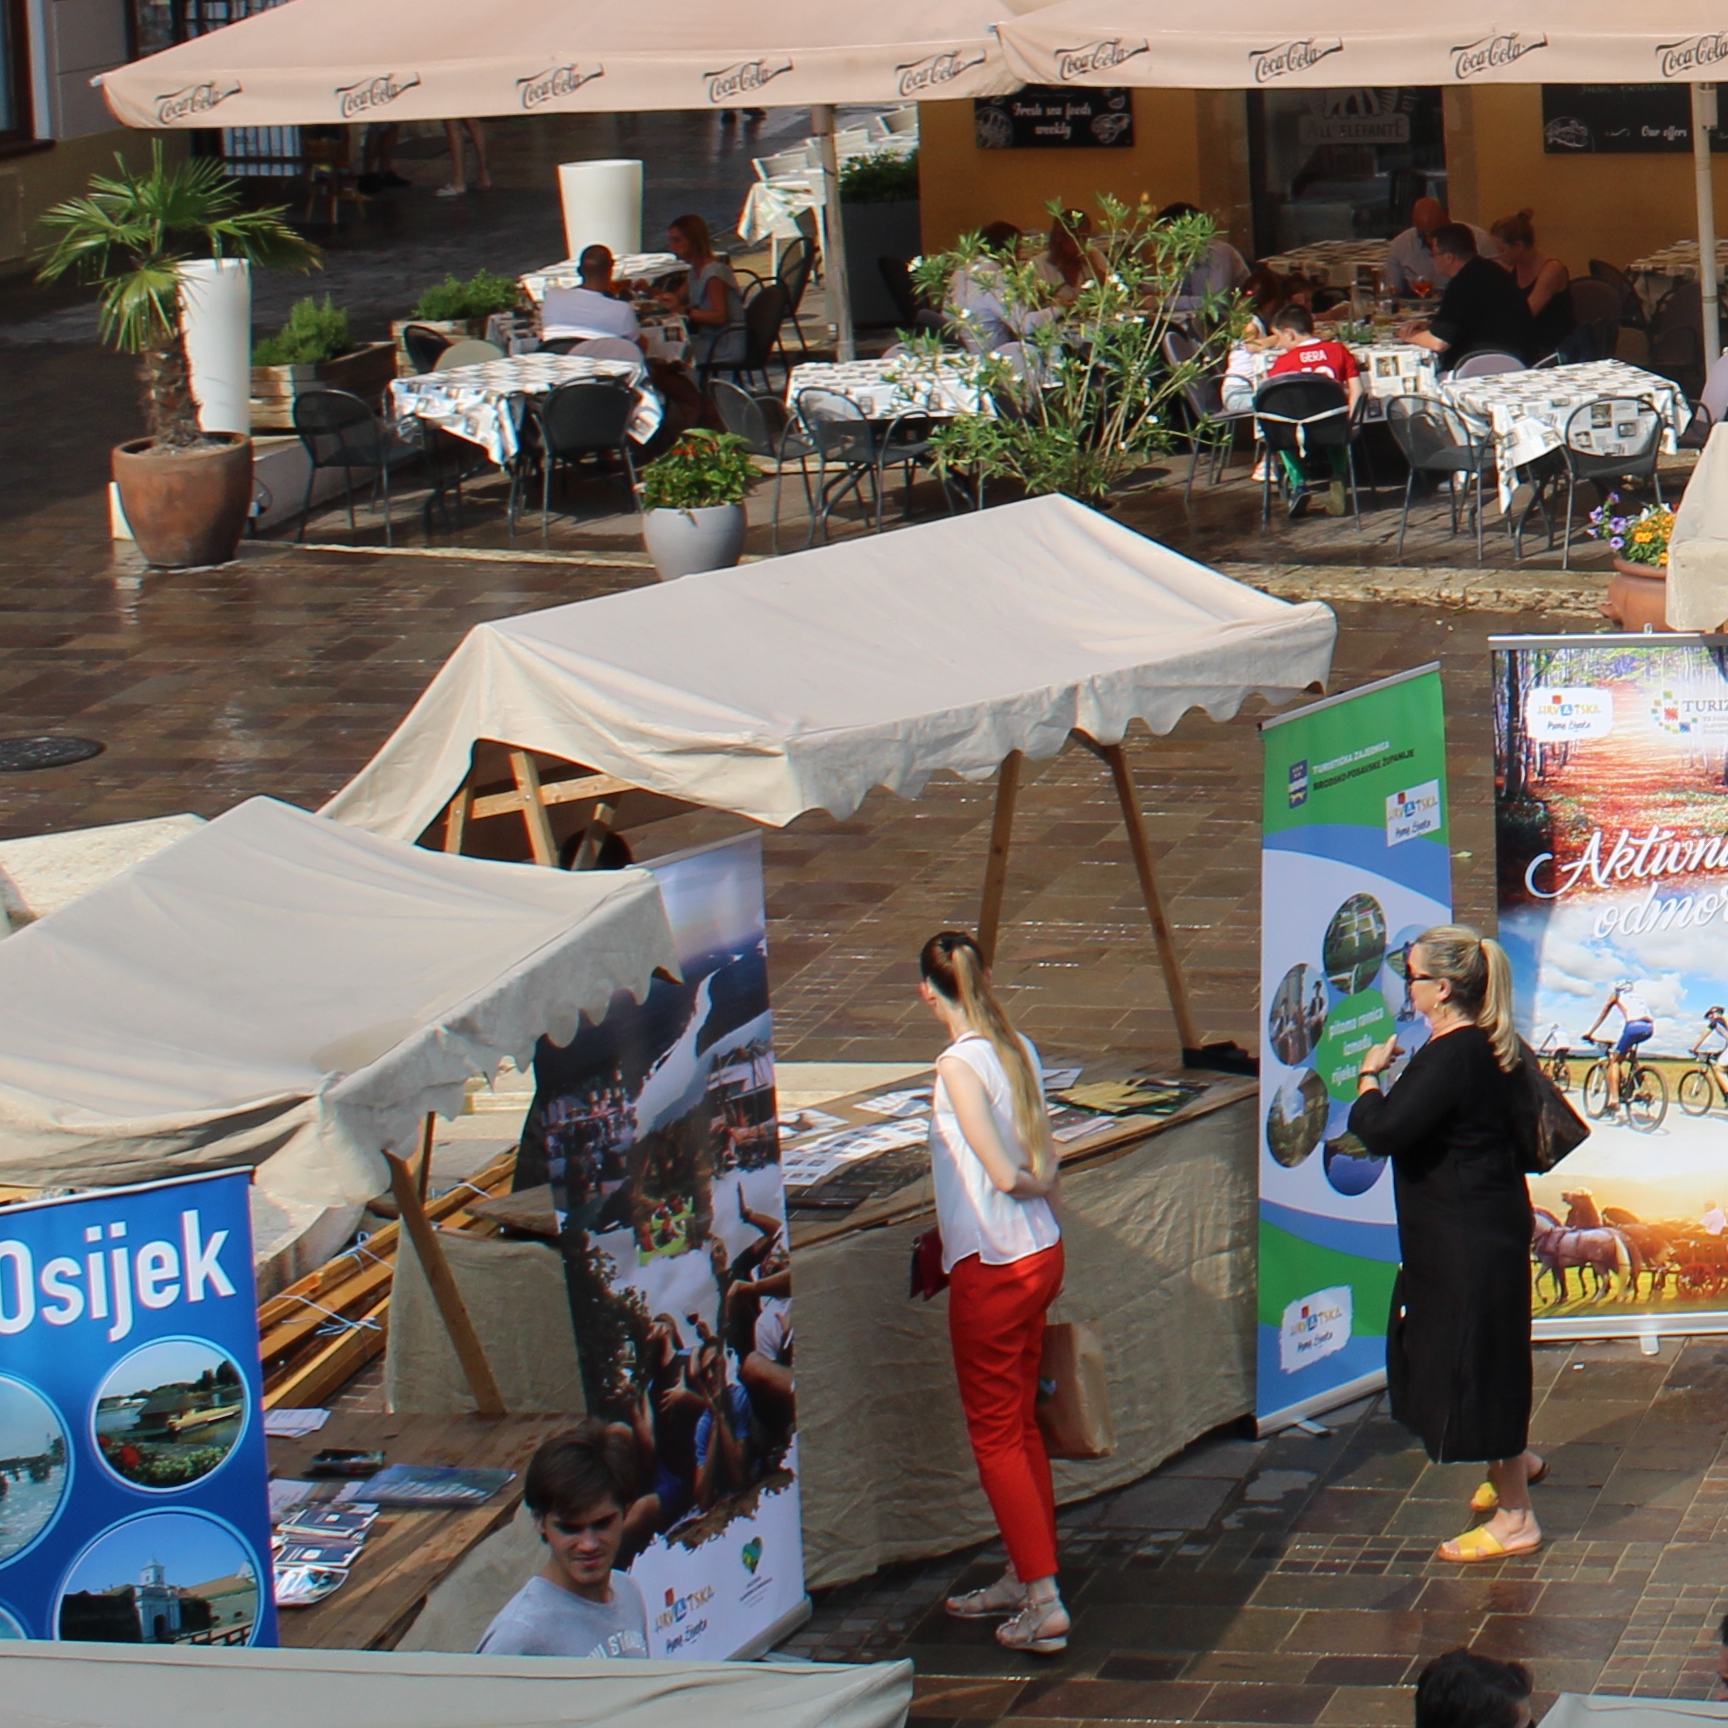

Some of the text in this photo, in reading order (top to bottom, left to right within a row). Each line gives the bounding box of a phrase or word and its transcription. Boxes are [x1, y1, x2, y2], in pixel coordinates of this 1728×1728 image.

[896, 49, 986, 96] Coca-Cola
[1055, 37, 1150, 80] Coca-Cola
[1248, 36, 1344, 82] Coca-Cola
[1450, 31, 1548, 79] Coca-Cola
[156, 80, 243, 124] Coca-Cola
[335, 72, 421, 118] Coca-Cola
[516, 63, 605, 109] Coca-Cola
[704, 57, 793, 104] Coca-Cola
[0, 1209, 237, 1342] Osijek
